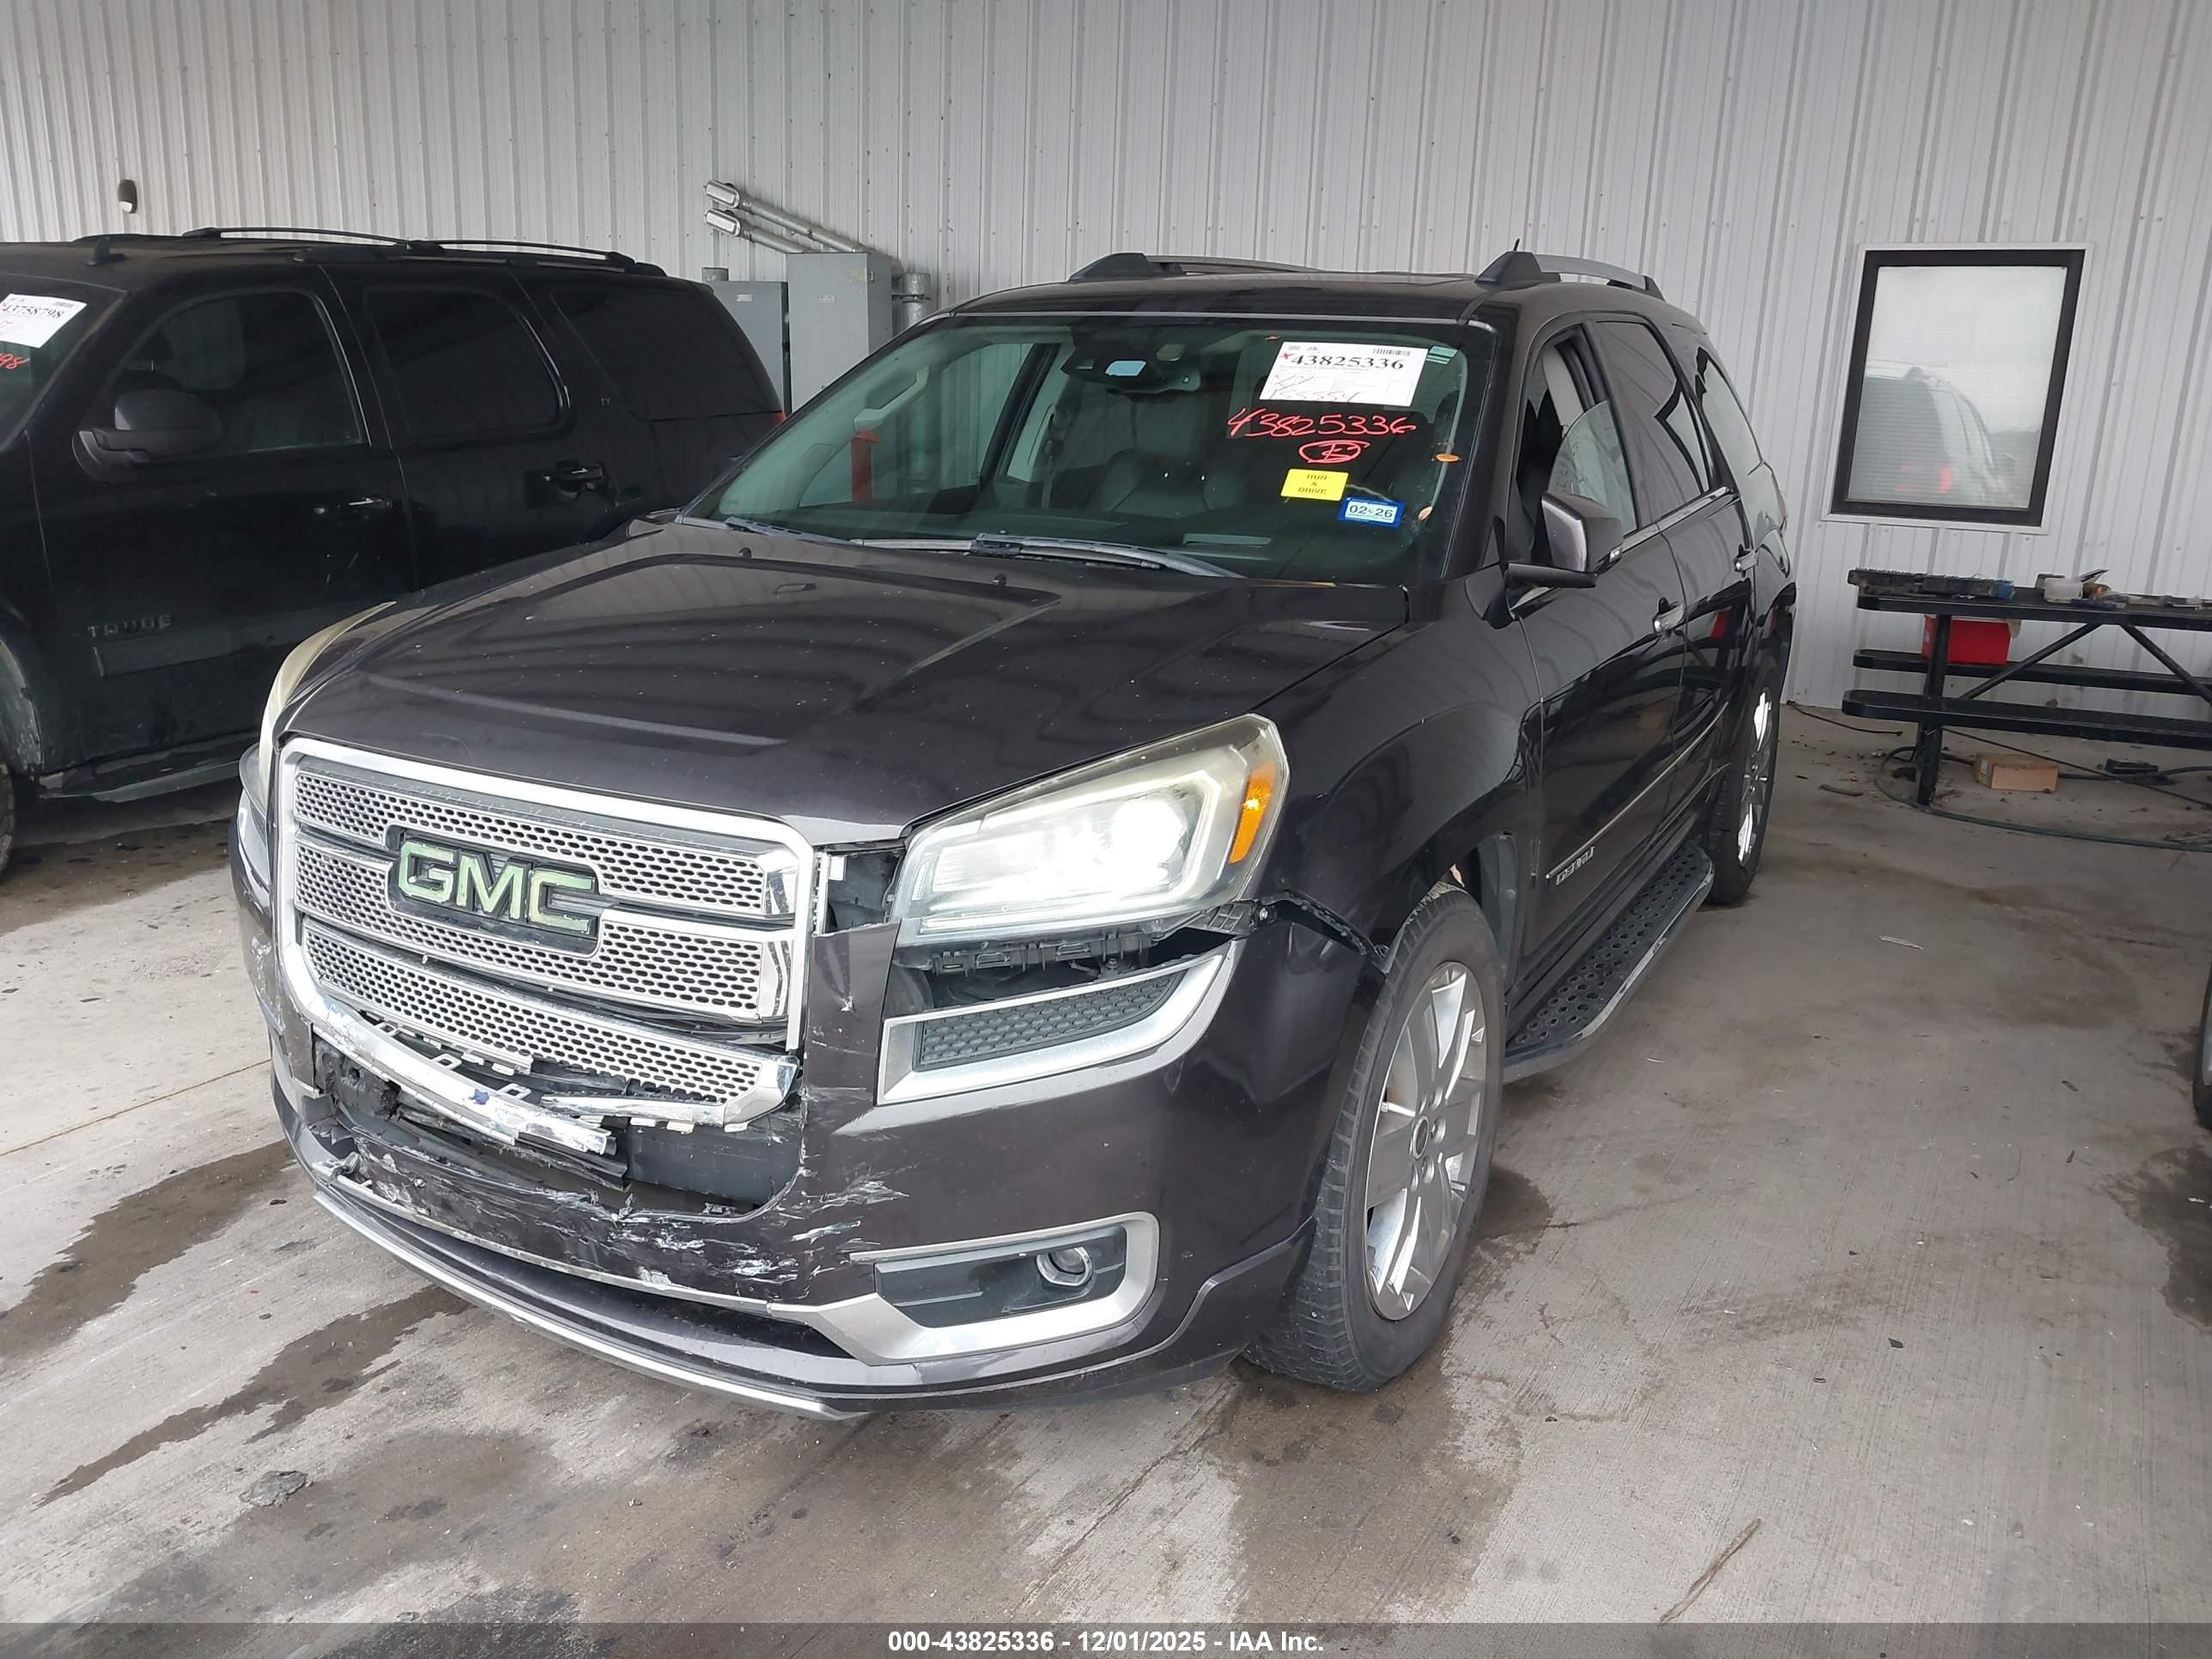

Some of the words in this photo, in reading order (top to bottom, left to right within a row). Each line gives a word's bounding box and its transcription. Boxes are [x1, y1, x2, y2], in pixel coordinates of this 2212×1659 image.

[1291, 355, 1404, 370] 43825336
[1227, 407, 1417, 437] 43825336
[398, 841, 596, 936] GMC
